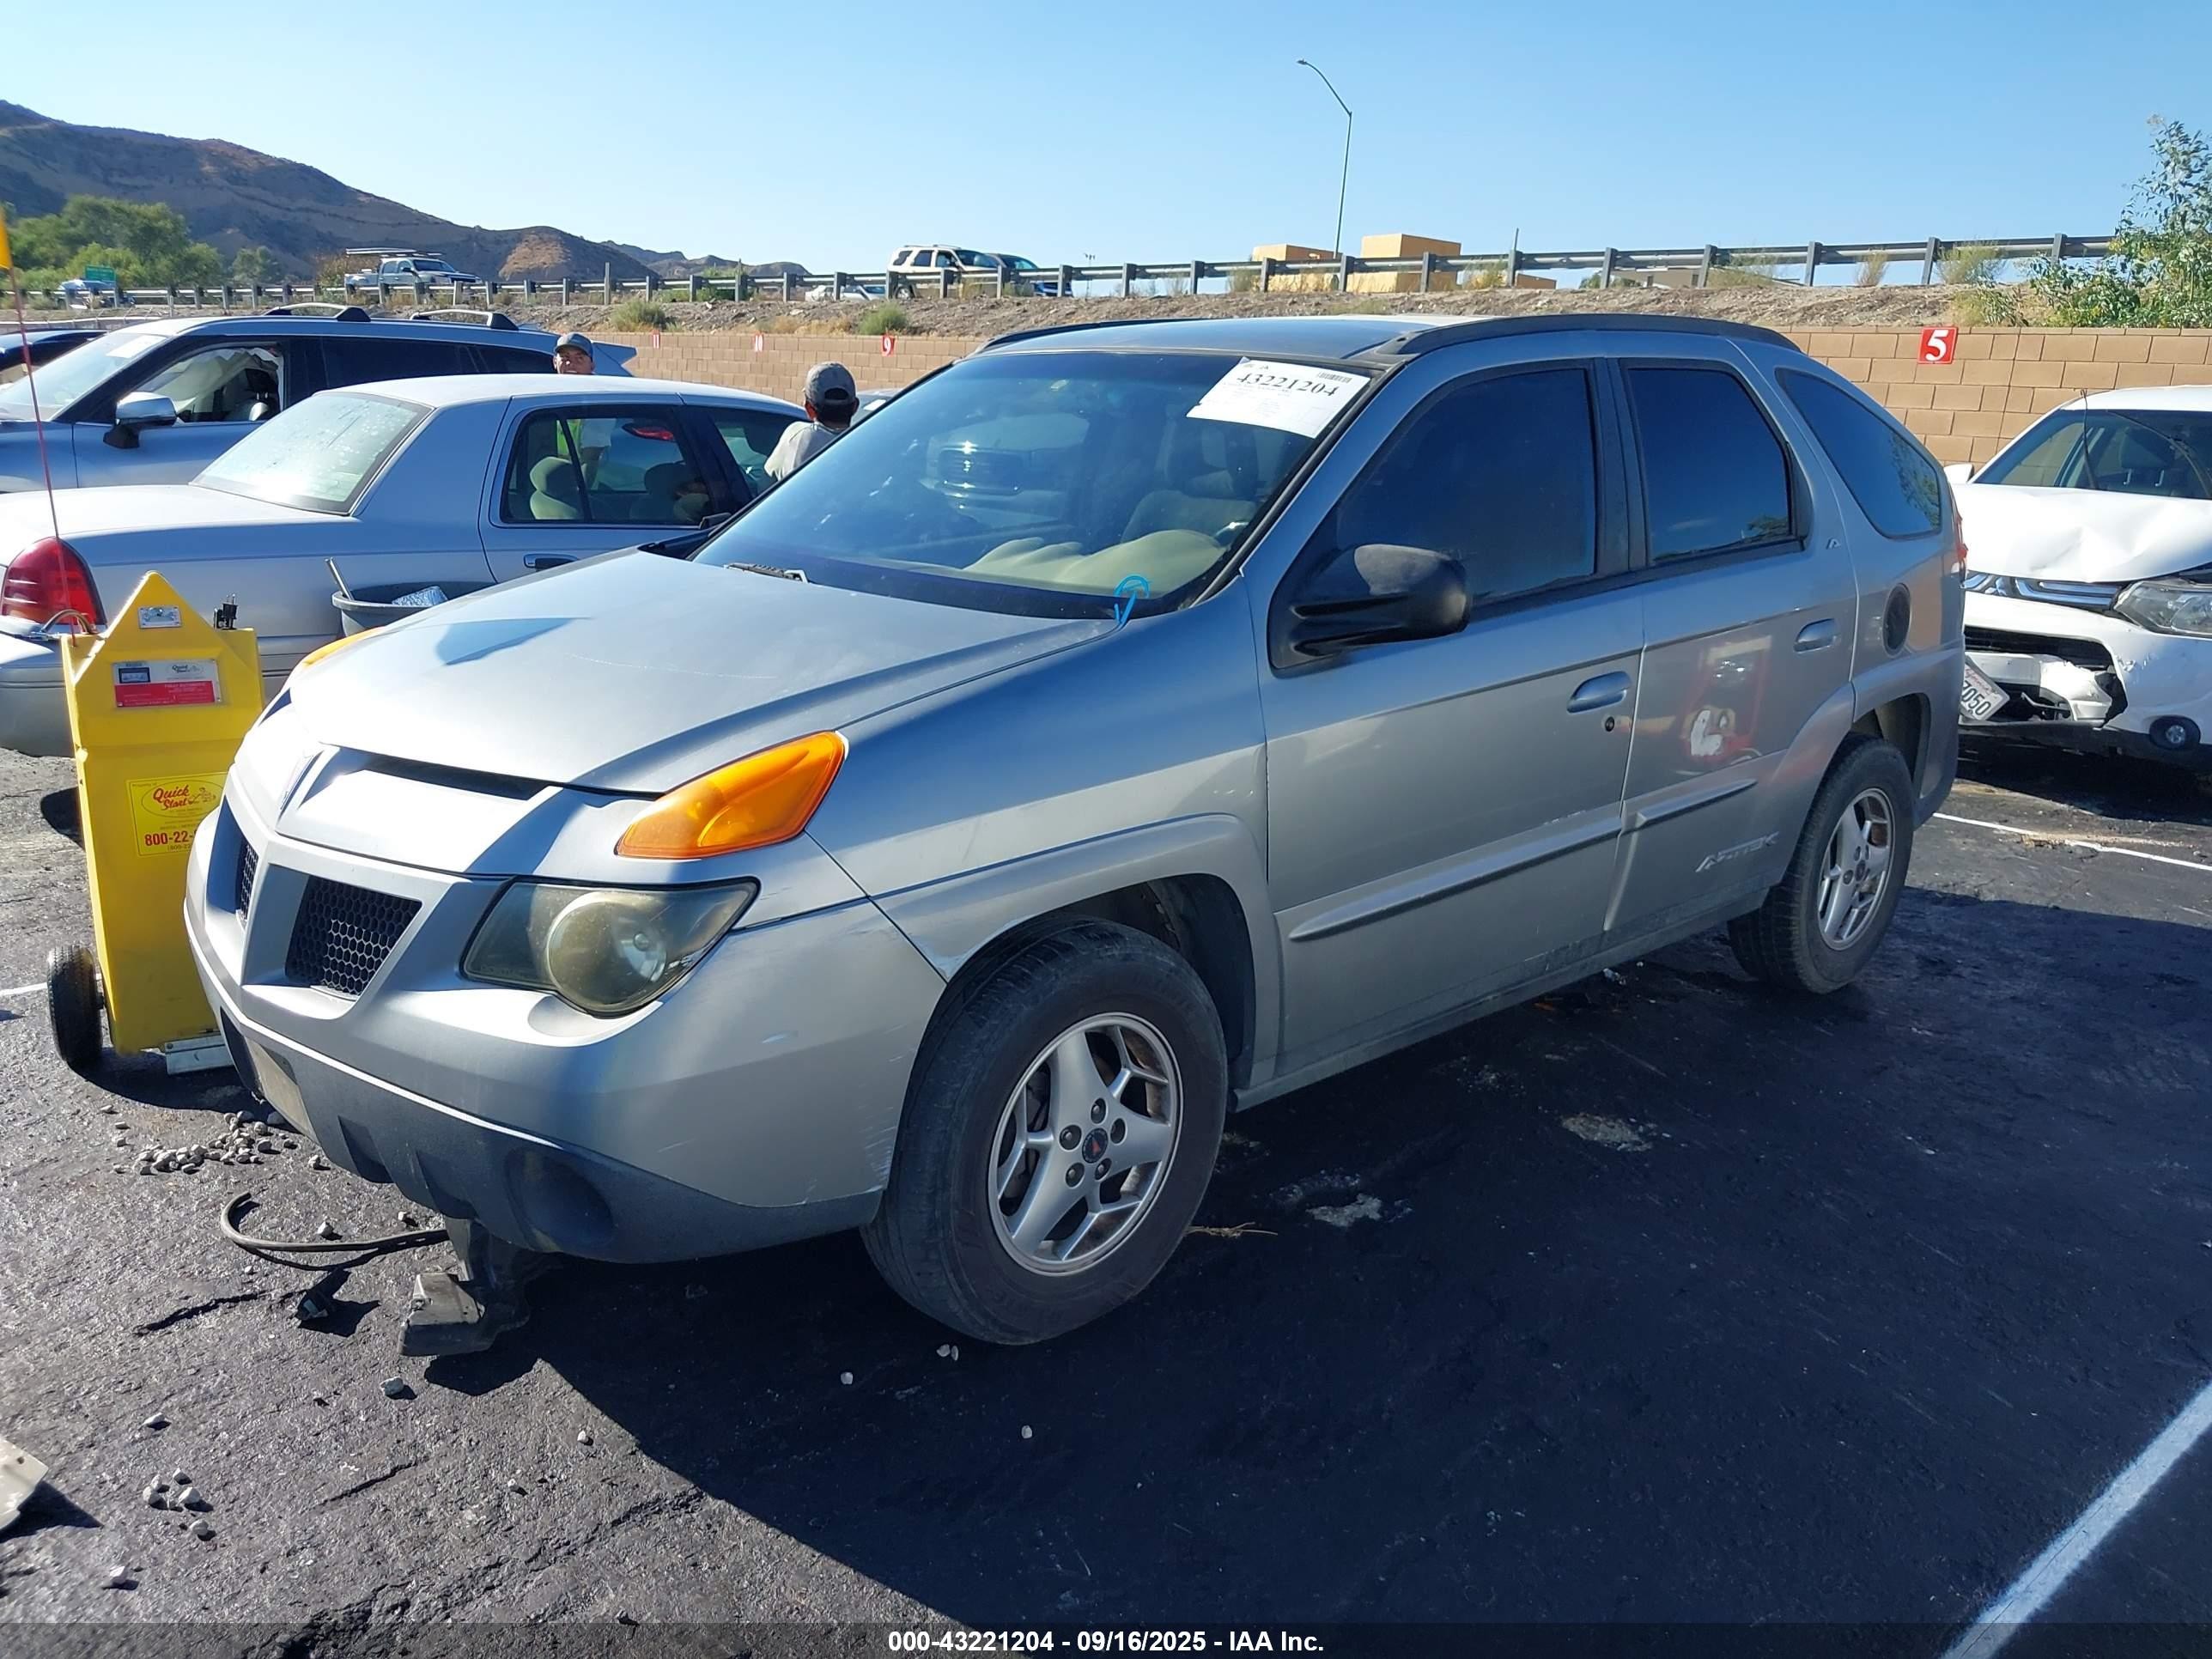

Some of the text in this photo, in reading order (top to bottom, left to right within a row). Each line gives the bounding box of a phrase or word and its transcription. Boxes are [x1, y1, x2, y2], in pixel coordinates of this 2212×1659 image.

[755, 334, 763, 352] 10
[883, 336, 892, 356] 9
[1925, 329, 1948, 362] 5
[1237, 373, 1340, 396] 43221204
[153, 785, 190, 804] Quick
[161, 799, 188, 811] Start
[144, 830, 198, 847] 800-22-
